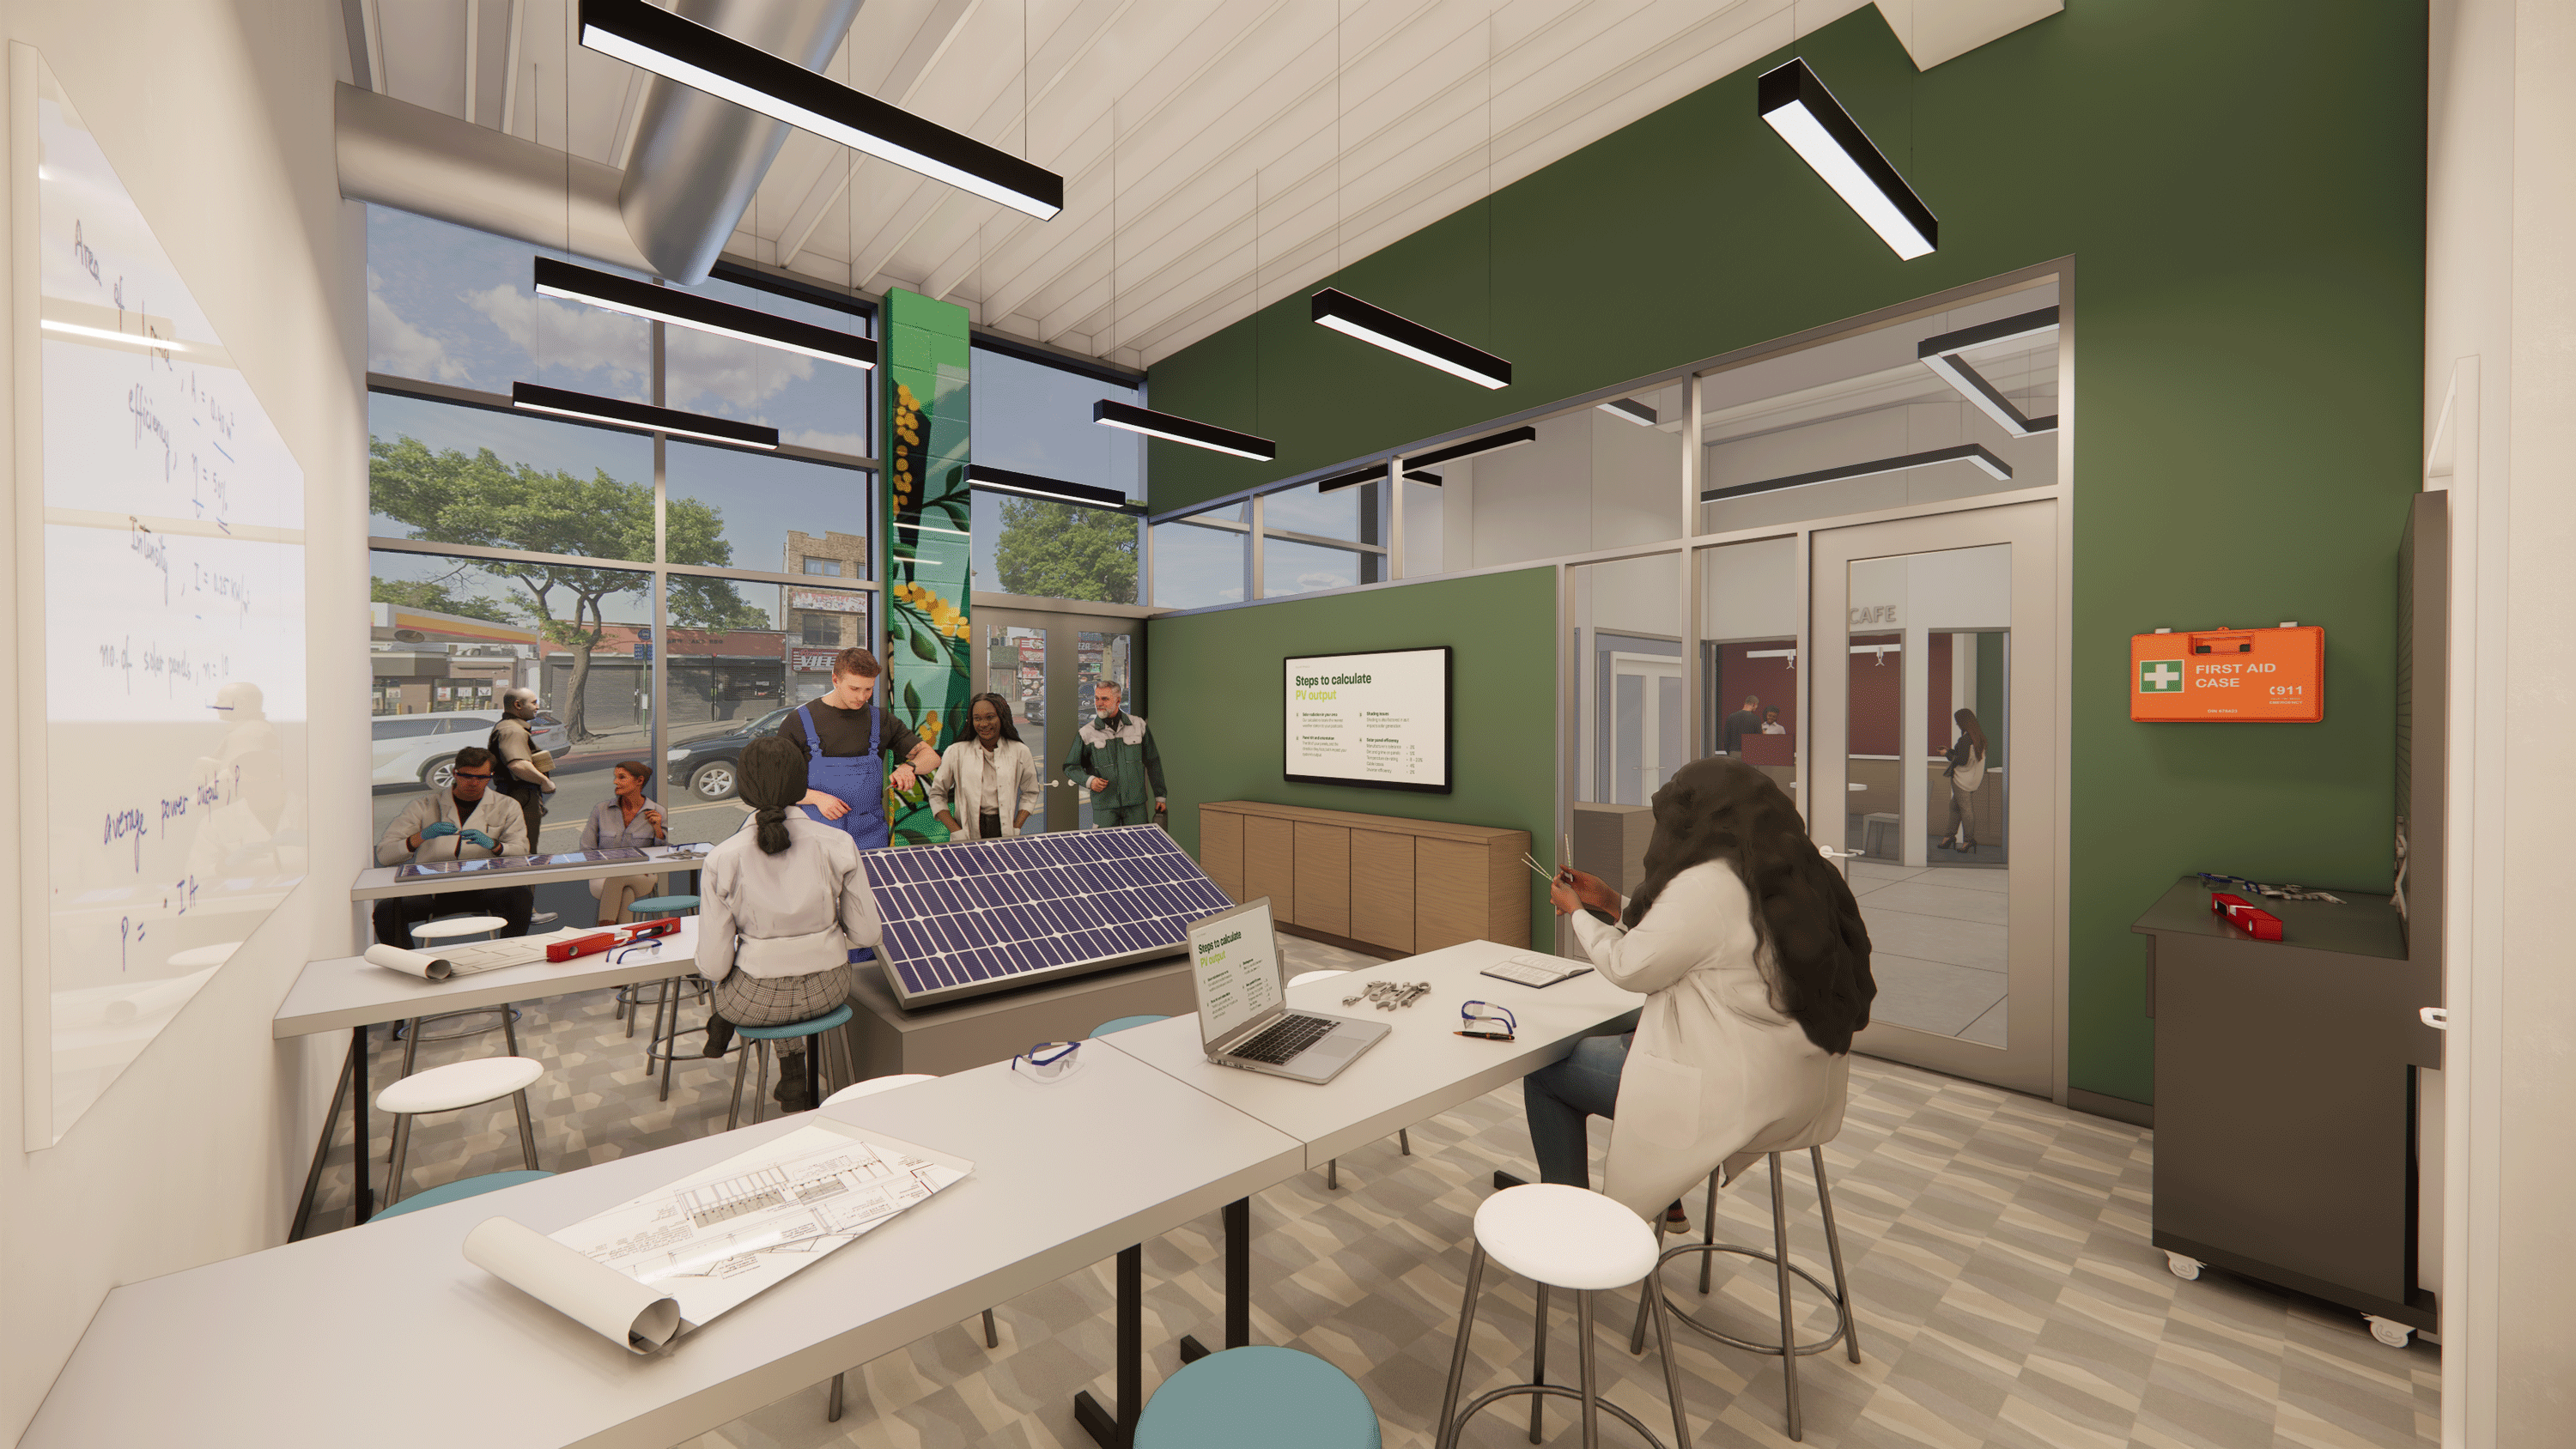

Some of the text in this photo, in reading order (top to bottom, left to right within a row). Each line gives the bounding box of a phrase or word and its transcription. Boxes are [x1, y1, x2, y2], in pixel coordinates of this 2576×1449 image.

[75, 219, 101, 288] Area
[113, 276, 125, 333] of
[1850, 605, 1897, 624] CAFE
[120, 634, 133, 696] of
[143, 641, 164, 678] solar
[2196, 664, 2276, 674] FIRST AID
[1296, 673, 1372, 688] Steps to calculate
[2196, 677, 2240, 688] CASE
[1296, 689, 1337, 703] PV output
[104, 809, 147, 874] average
[161, 796, 188, 840] power
[1198, 931, 1242, 955] Steps to calculate
[1200, 949, 1226, 968] PV output
